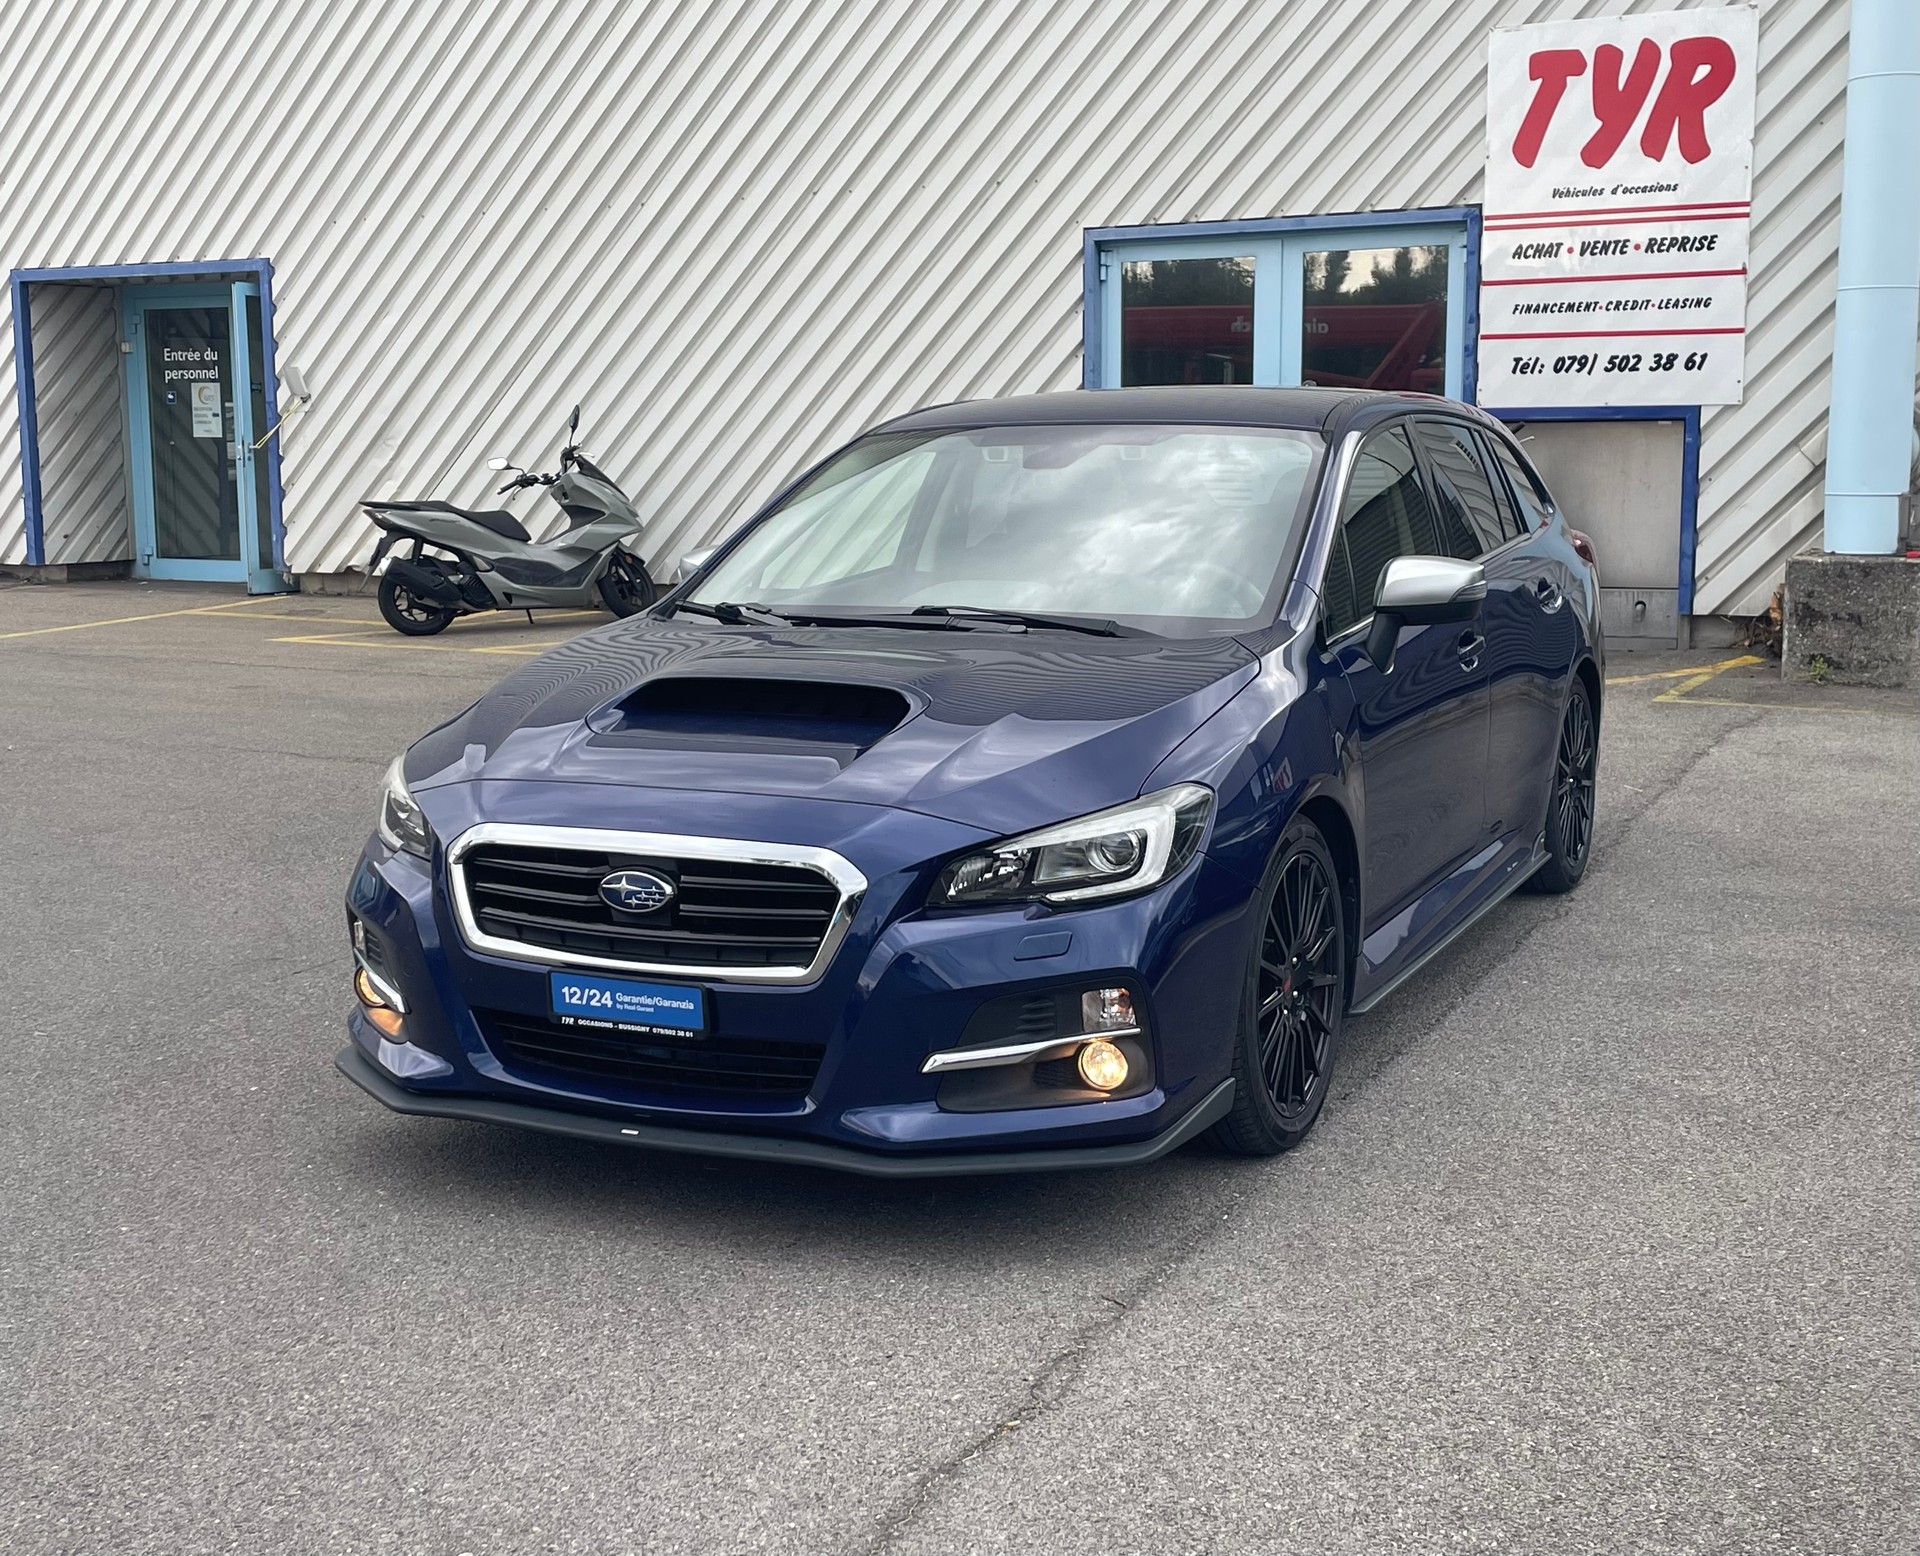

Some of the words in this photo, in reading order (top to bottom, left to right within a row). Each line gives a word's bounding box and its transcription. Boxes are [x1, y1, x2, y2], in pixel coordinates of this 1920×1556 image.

[1512, 36, 1736, 169] TYR
[1552, 185, 1604, 199] Véhicules
[1610, 182, 1679, 196] d'occasions
[1511, 241, 1563, 260] ACHAT
[1579, 238, 1631, 257] VENTE
[1644, 234, 1718, 253] REPRISE
[163, 347, 201, 362] Entrée
[204, 347, 218, 361] du
[1511, 356, 1545, 375] Tél:
[1604, 353, 1642, 373] 502
[1648, 352, 1679, 372] 38
[1684, 351, 1708, 371] 61
[164, 366, 219, 383] personnel
[561, 985, 613, 1008] 12/24
[615, 992, 695, 1010] Garantie/Garanzia
[561, 1016, 574, 1025] TYR
[577, 1019, 613, 1029] OCCASIONS
[618, 1023, 650, 1033] BUSSIGNY
